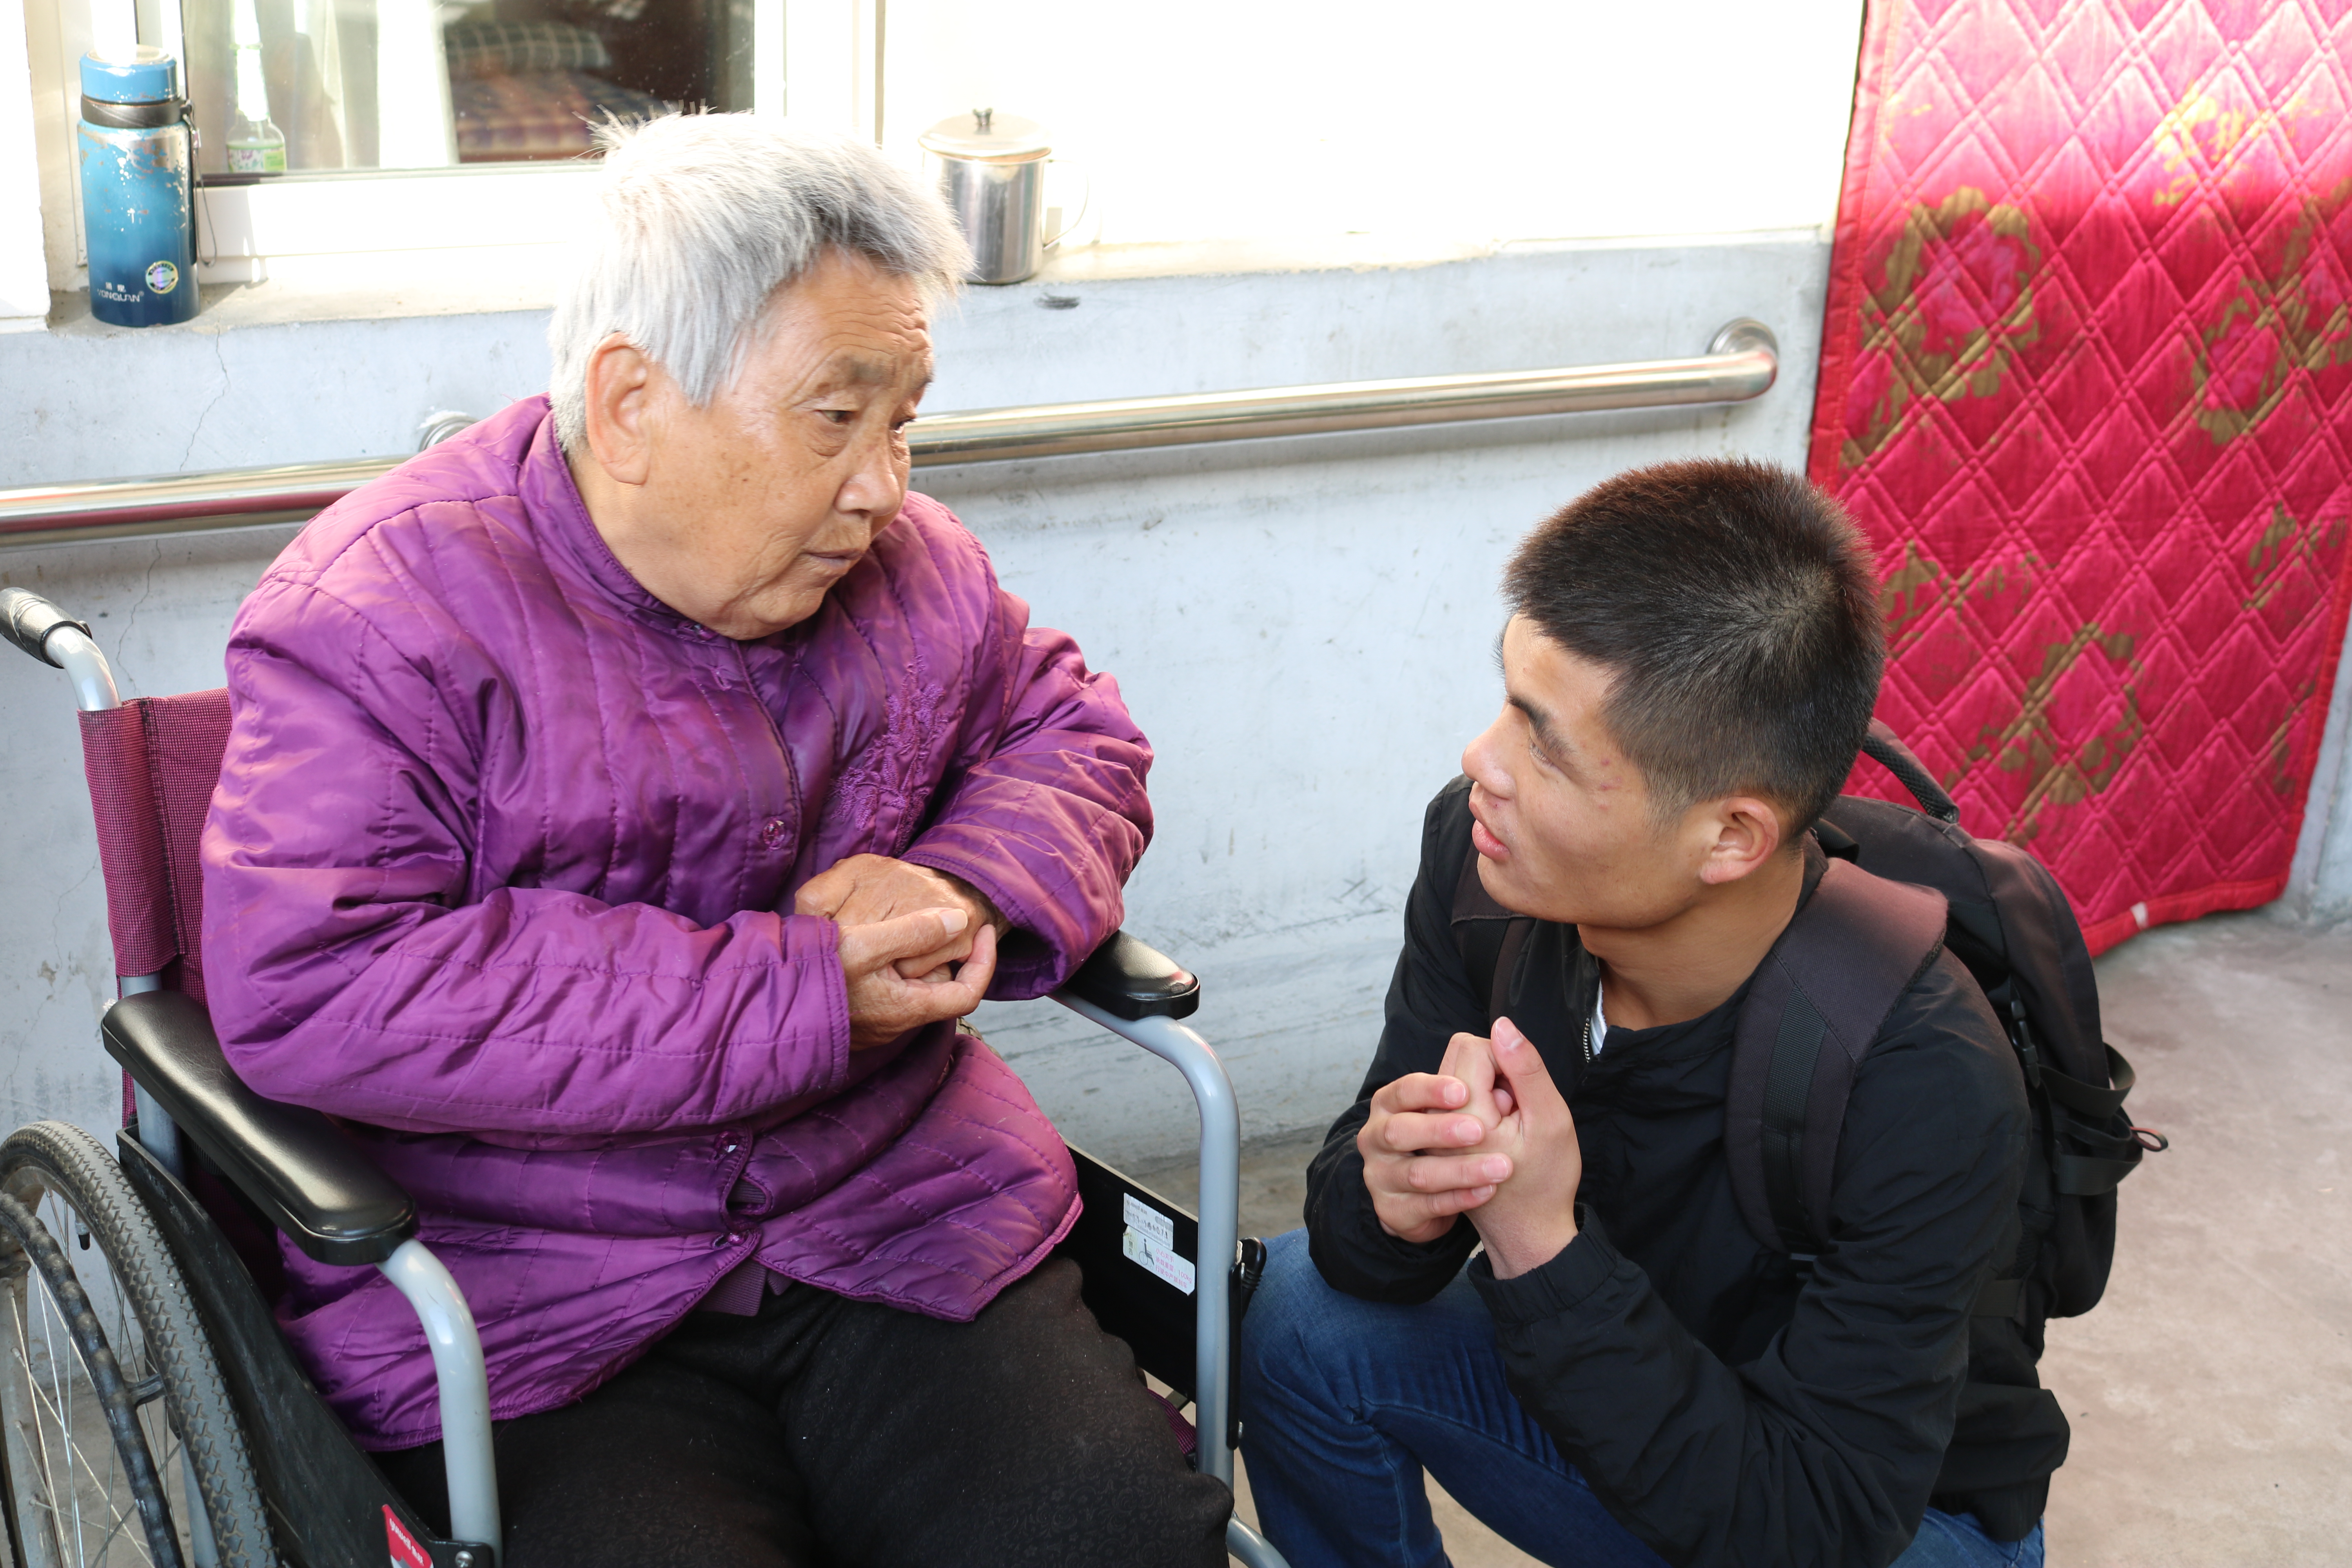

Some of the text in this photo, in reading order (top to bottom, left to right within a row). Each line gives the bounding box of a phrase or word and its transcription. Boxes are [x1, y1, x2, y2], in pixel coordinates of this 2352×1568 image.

[1156, 1248, 1174, 1263] 小心夹手
[389, 1518, 411, 1550] yuwell
